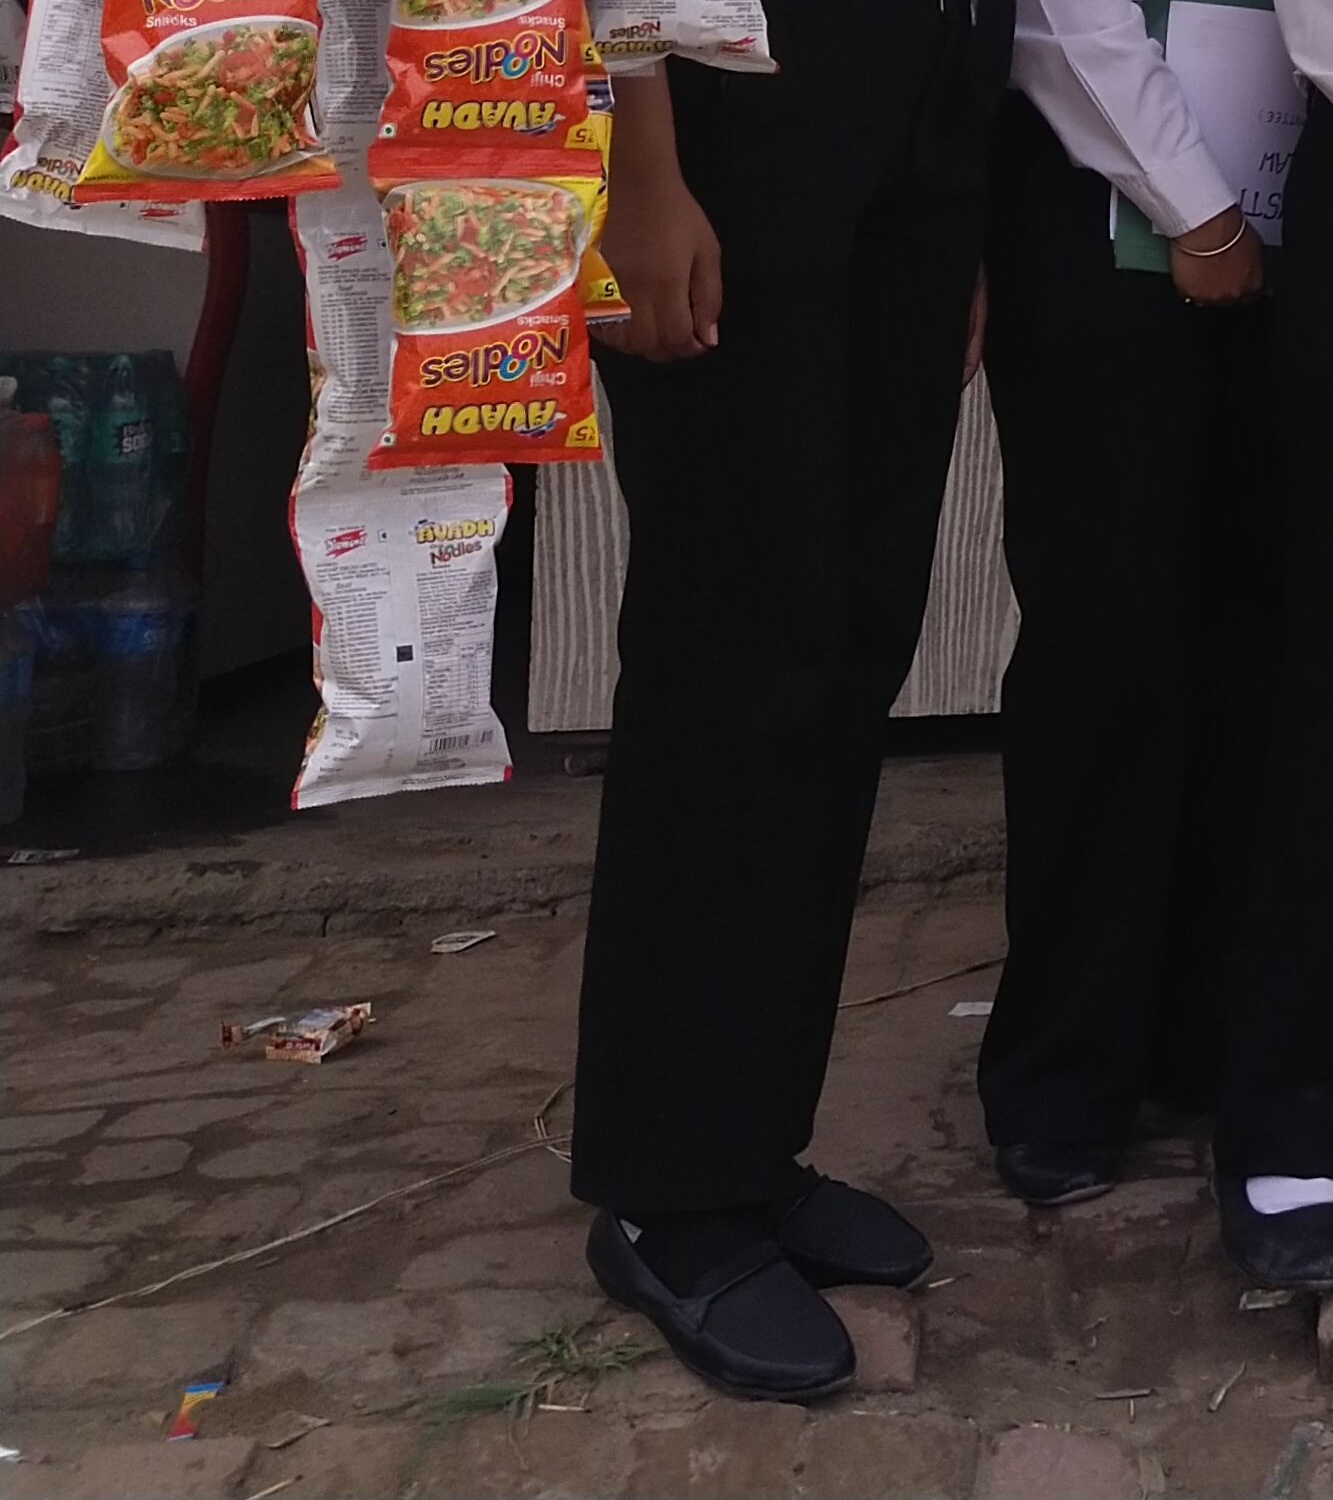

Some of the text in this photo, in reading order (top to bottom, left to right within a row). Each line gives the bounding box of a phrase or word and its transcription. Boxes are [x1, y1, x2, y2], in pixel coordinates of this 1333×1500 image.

[145, 15, 198, 29] Snacks
[517, 14, 566, 30] Snacks
[424, 29, 567, 85] Noodles
[530, 73, 566, 88] Chiji
[421, 100, 557, 131] AVADH
[516, 313, 570, 327] Snacks
[420, 325, 569, 389] Noodles
[530, 371, 567, 387] Chiji
[421, 400, 558, 437] AVADH
[416, 518, 496, 544] AVADH
[430, 540, 483, 566] Noodles
